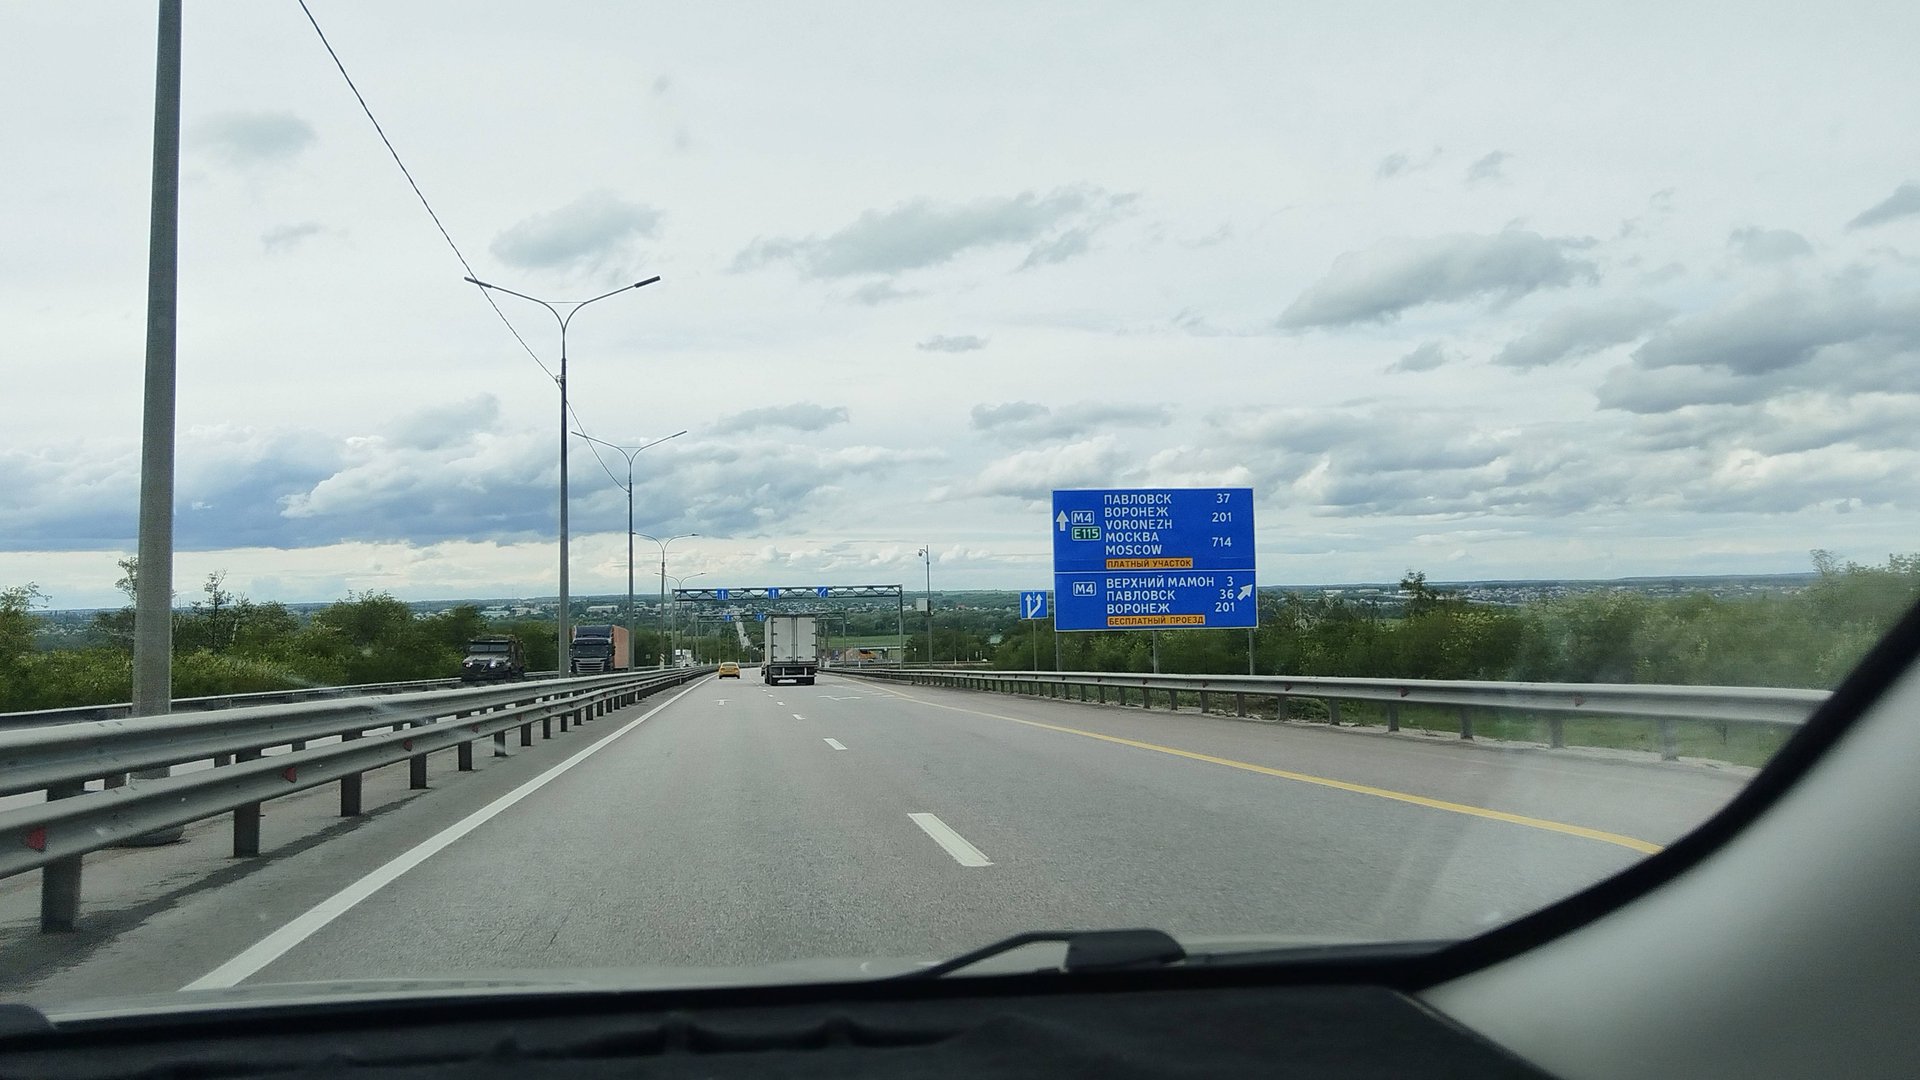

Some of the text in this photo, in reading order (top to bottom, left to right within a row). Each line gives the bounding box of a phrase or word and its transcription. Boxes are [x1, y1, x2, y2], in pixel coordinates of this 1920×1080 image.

[1104, 494, 1230, 505] ПАВЛОВСК 37
[1105, 507, 1168, 517] ВОРОНЕЖ
[1105, 512, 1232, 530] VORONEZH 201
[1074, 529, 1099, 538] E115
[1106, 532, 1159, 542] МОСКВА
[1106, 537, 1232, 555] MOSCOW 714
[1107, 560, 1150, 568] ПЛАТНЫЙ
[1107, 575, 1233, 588] ВЕРХНИЙ МАМОН 3
[1107, 589, 1234, 601] ПАВЛОВСК 36
[1107, 602, 1235, 614] ВОРОНЕЖ 201
[1109, 616, 1166, 625] БЕСПЛАТНЫЙ
